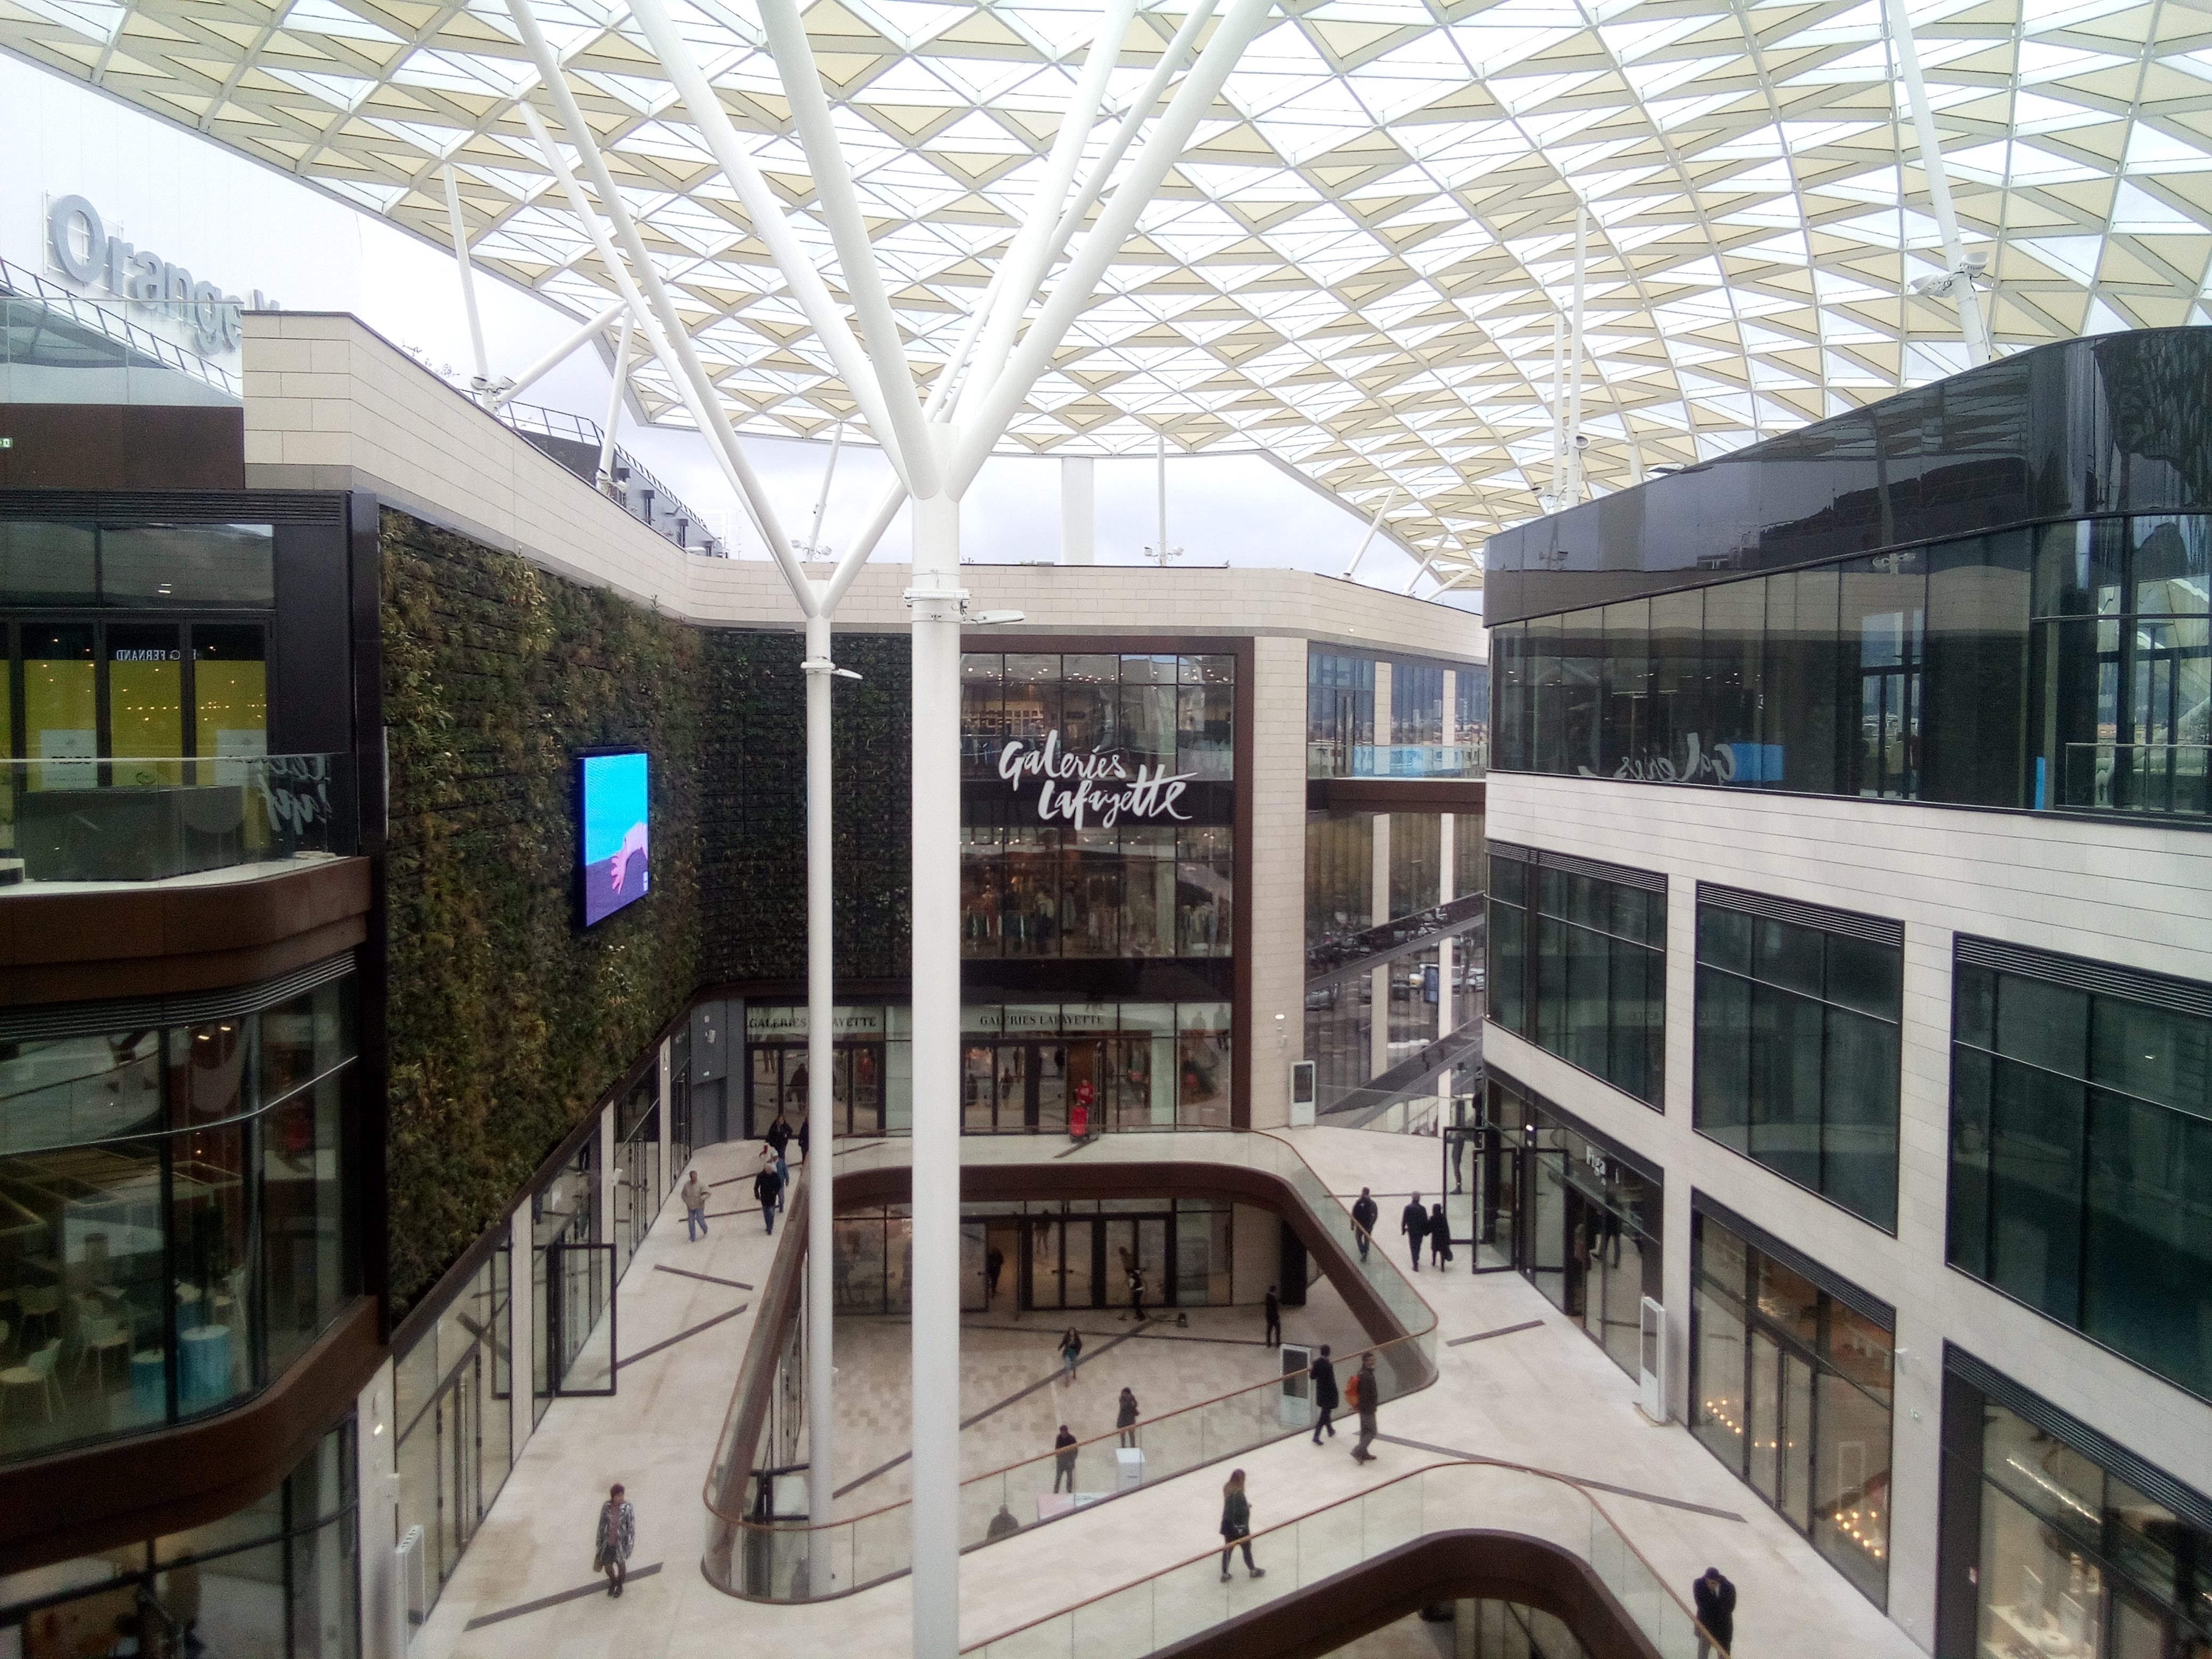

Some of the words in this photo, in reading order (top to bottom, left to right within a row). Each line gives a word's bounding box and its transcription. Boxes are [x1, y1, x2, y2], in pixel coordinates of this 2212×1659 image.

[998, 729, 1127, 791] Galeries
[1038, 764, 1197, 831] Lafayette
[833, 1017, 877, 1027] AYETTE
